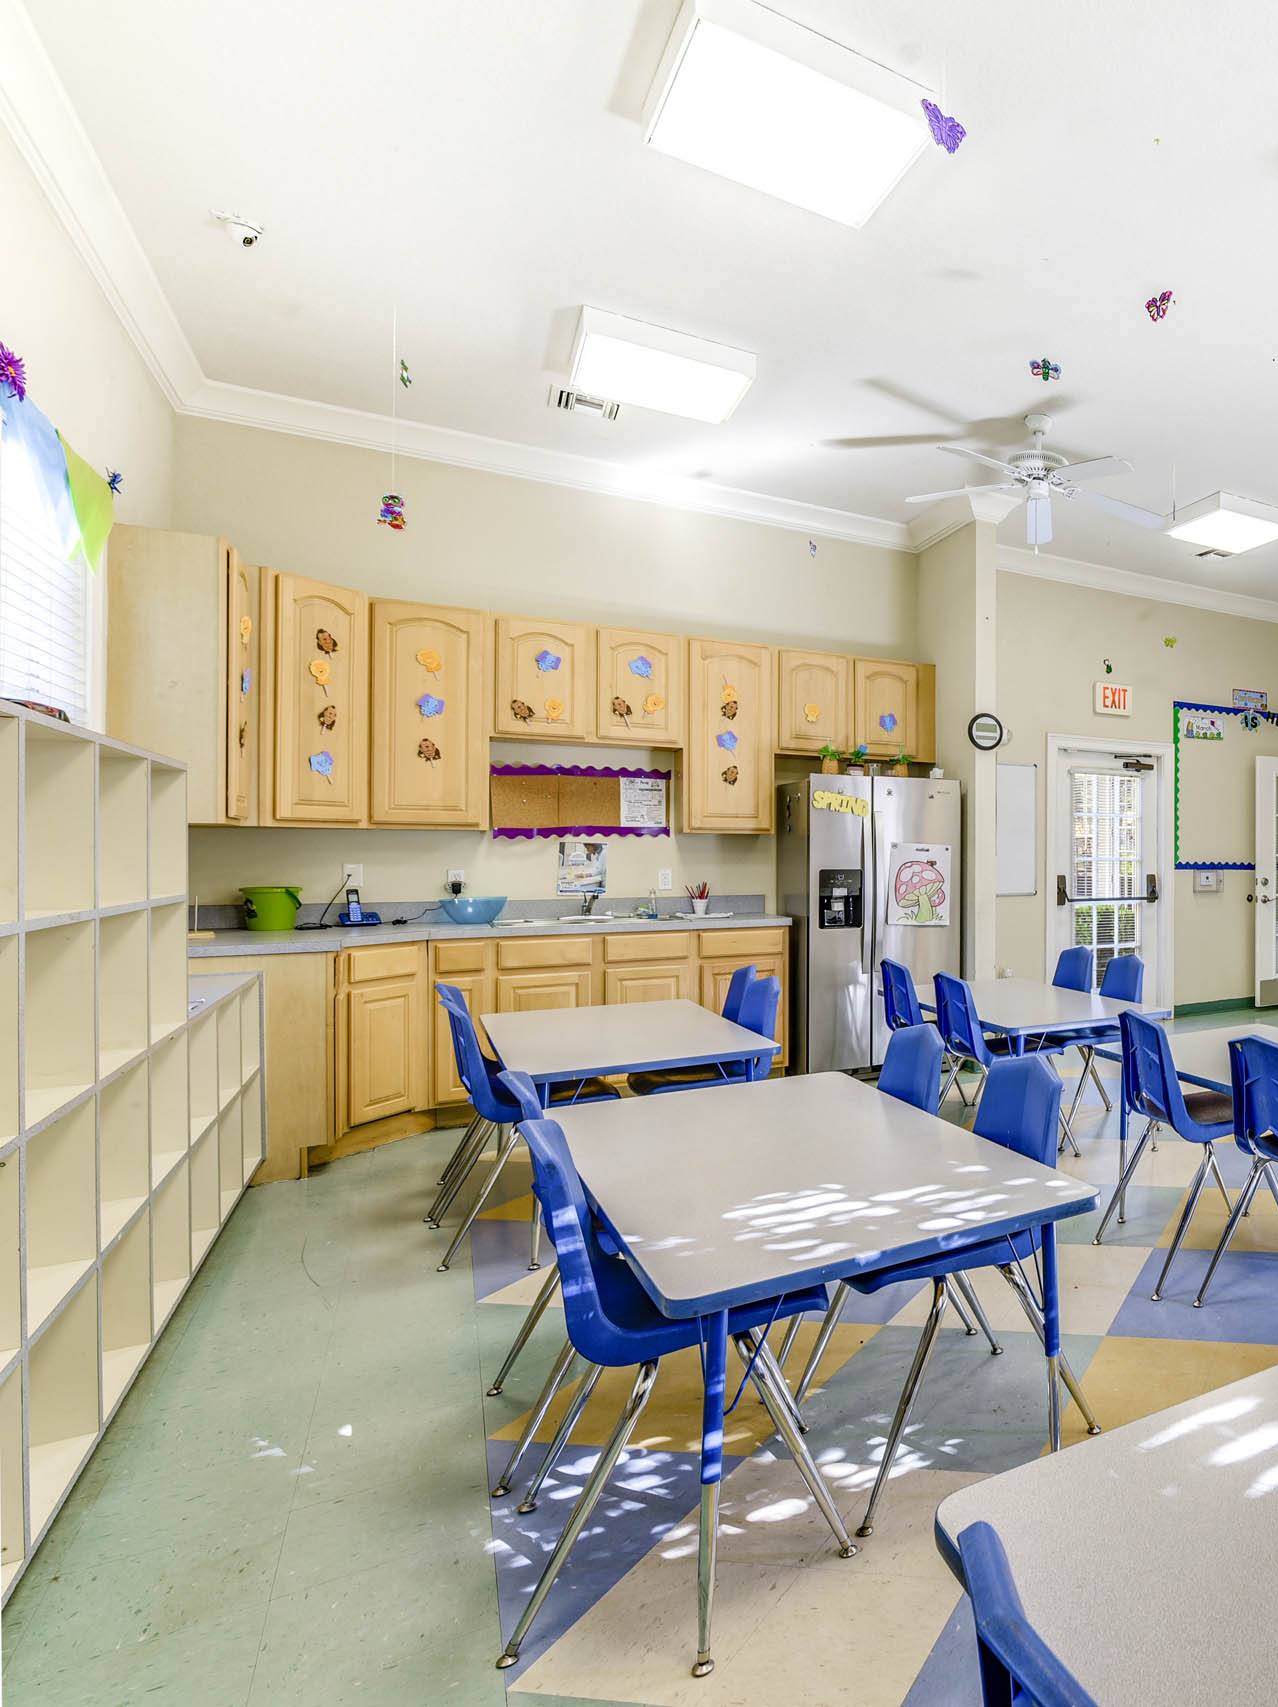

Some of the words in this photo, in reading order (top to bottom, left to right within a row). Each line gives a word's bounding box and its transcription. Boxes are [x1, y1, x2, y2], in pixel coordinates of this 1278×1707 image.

[1103, 686, 1128, 710] EXIT
[1244, 714, 1258, 729] IS
[812, 790, 869, 817] SPRING
